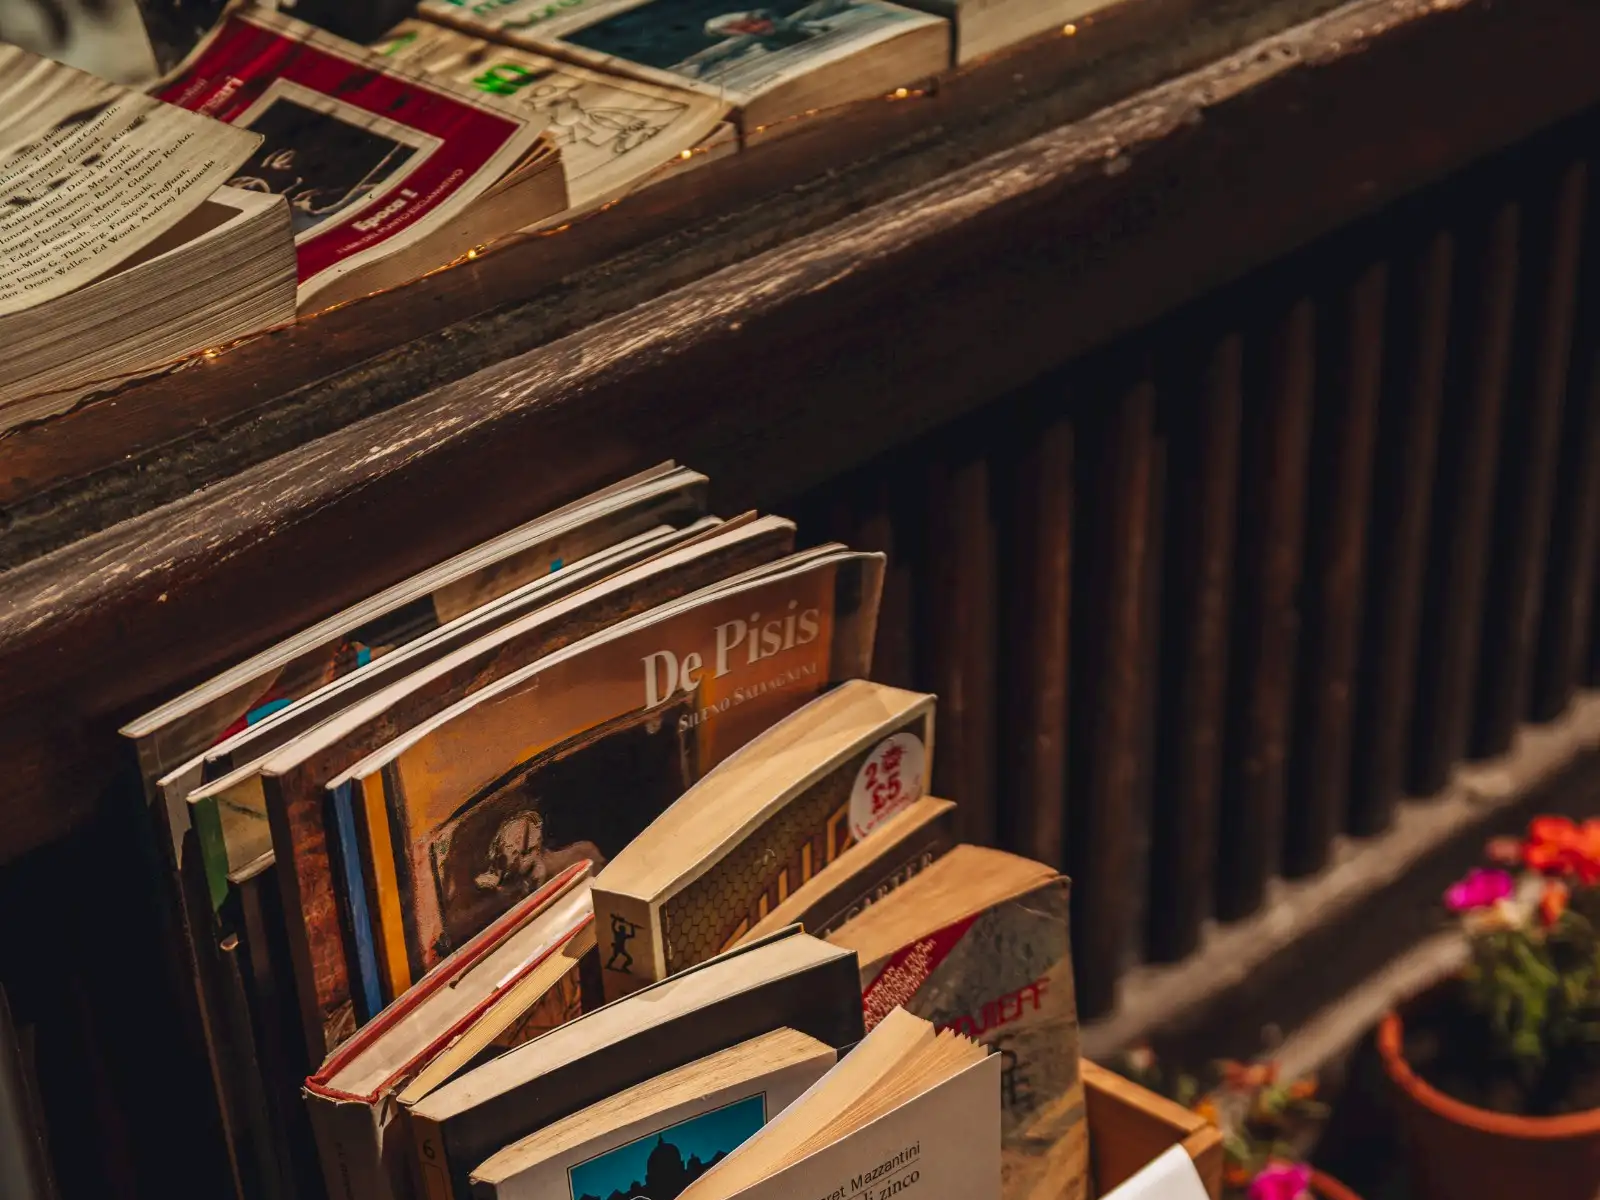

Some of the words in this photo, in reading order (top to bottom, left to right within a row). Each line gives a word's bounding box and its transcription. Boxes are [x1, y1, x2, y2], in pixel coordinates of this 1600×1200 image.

[83, 106, 121, 138] Coppola,
[66, 170, 95, 192] David
[96, 144, 131, 171] Mamet,
[67, 137, 104, 164] Godard,
[94, 176, 125, 199] Robert
[124, 147, 160, 176] Parrish,
[9, 245, 40, 263] Edgar
[41, 229, 71, 246] Reitz,
[70, 213, 94, 230] Jean
[93, 189, 129, 214] Renoir,
[127, 159, 163, 188] Glauber
[162, 131, 195, 159] Rocha,
[32, 219, 44, 227] de
[45, 192, 88, 218] Oliveira,
[87, 174, 108, 190] Max
[52, 229, 90, 252] Straub,
[90, 207, 120, 230] Seijun
[120, 181, 157, 208] Suzuki,
[351, 198, 408, 231] Epoca
[16, 266, 49, 283] Irving
[60, 231, 109, 260] Thalberg,
[108, 201, 149, 231] François
[148, 168, 191, 201] Truffaut,
[24, 275, 55, 291] Orson
[54, 255, 92, 276] Welles,
[91, 242, 108, 256] Ed
[107, 224, 140, 244] Wood,
[141, 195, 176, 223] Andrzej
[641, 649, 703, 713] De
[713, 599, 820, 680] Pisis
[850, 1140, 921, 1192] Mazzantini
